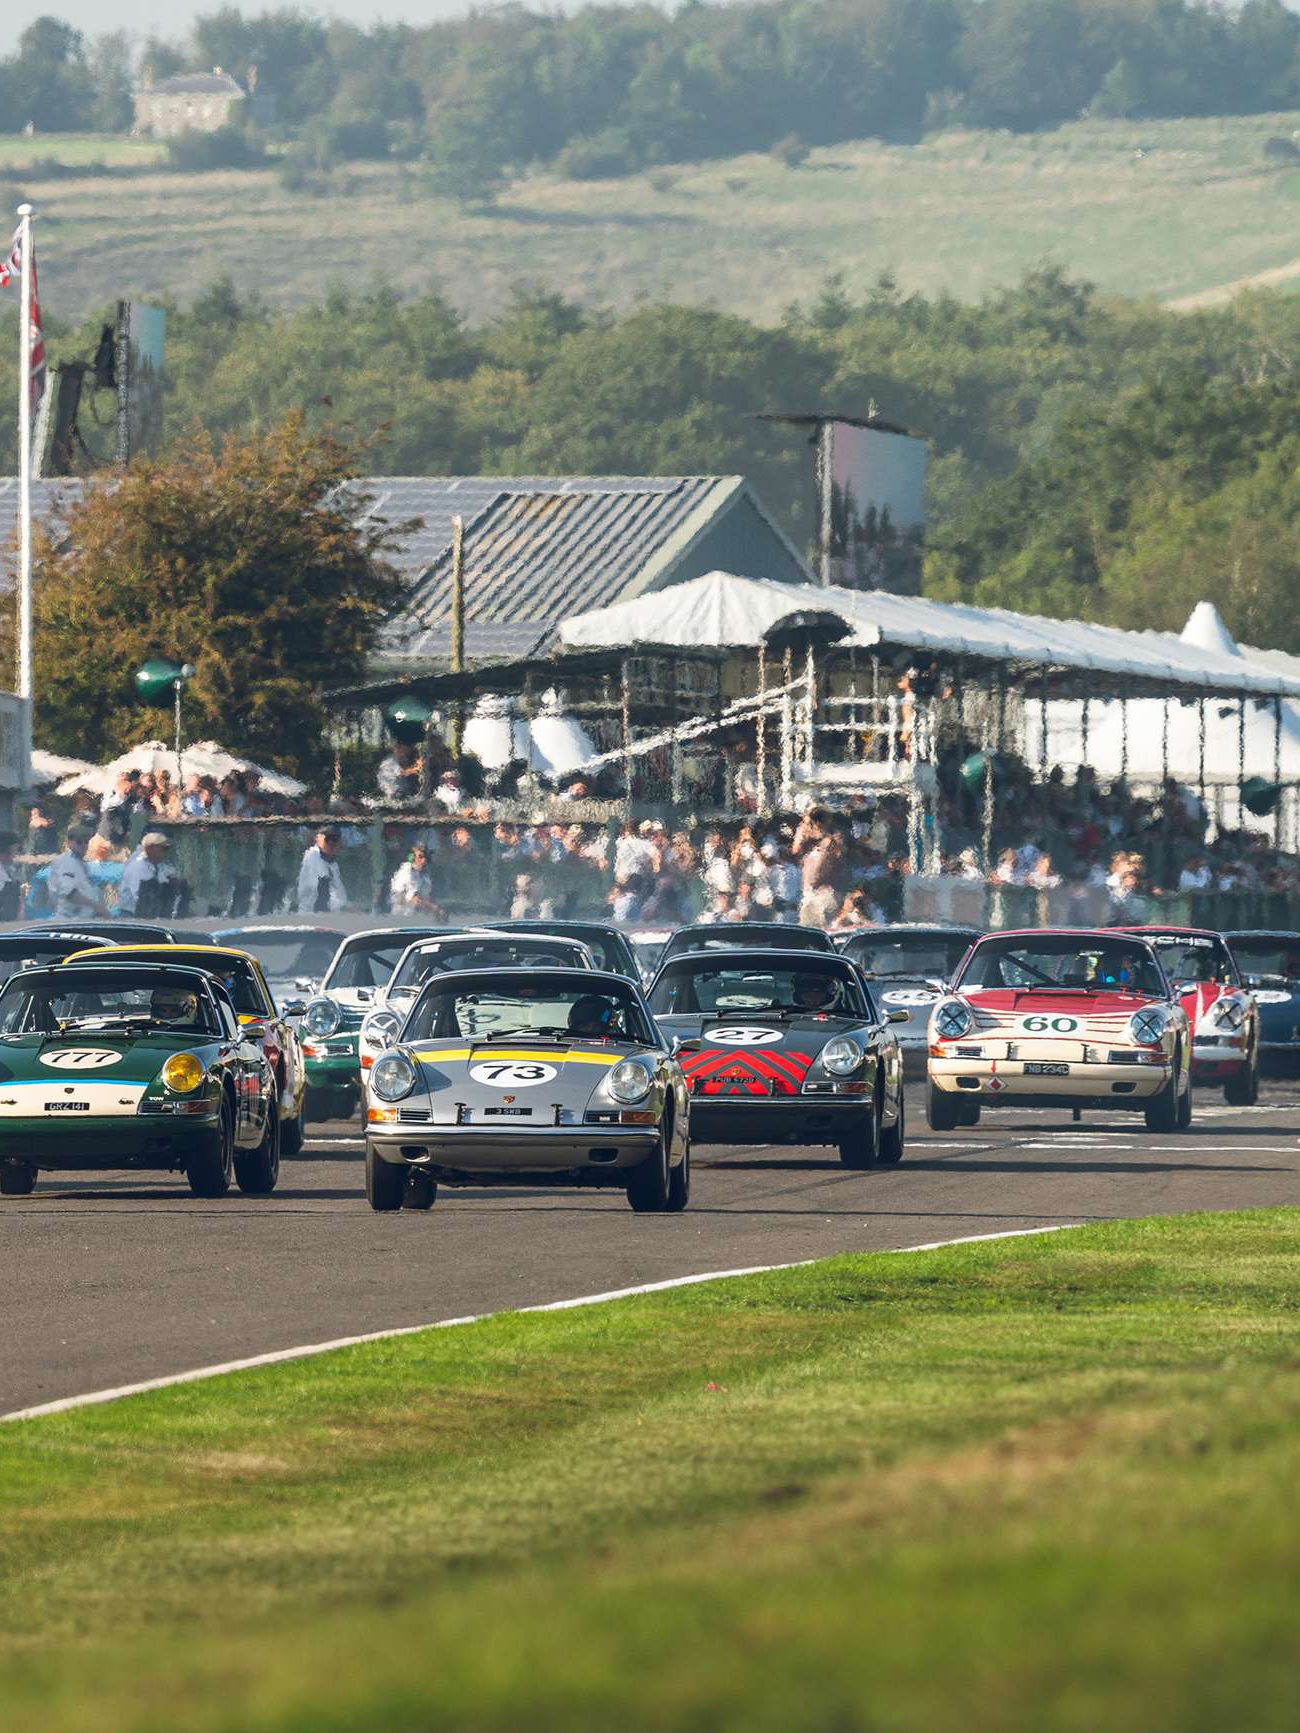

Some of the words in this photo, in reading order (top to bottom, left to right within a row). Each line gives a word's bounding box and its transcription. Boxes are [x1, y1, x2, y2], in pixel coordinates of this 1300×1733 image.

[1022, 1016, 1079, 1033] 60
[714, 1029, 775, 1041] 27
[51, 1051, 116, 1064] 777
[482, 1065, 546, 1080] 73
